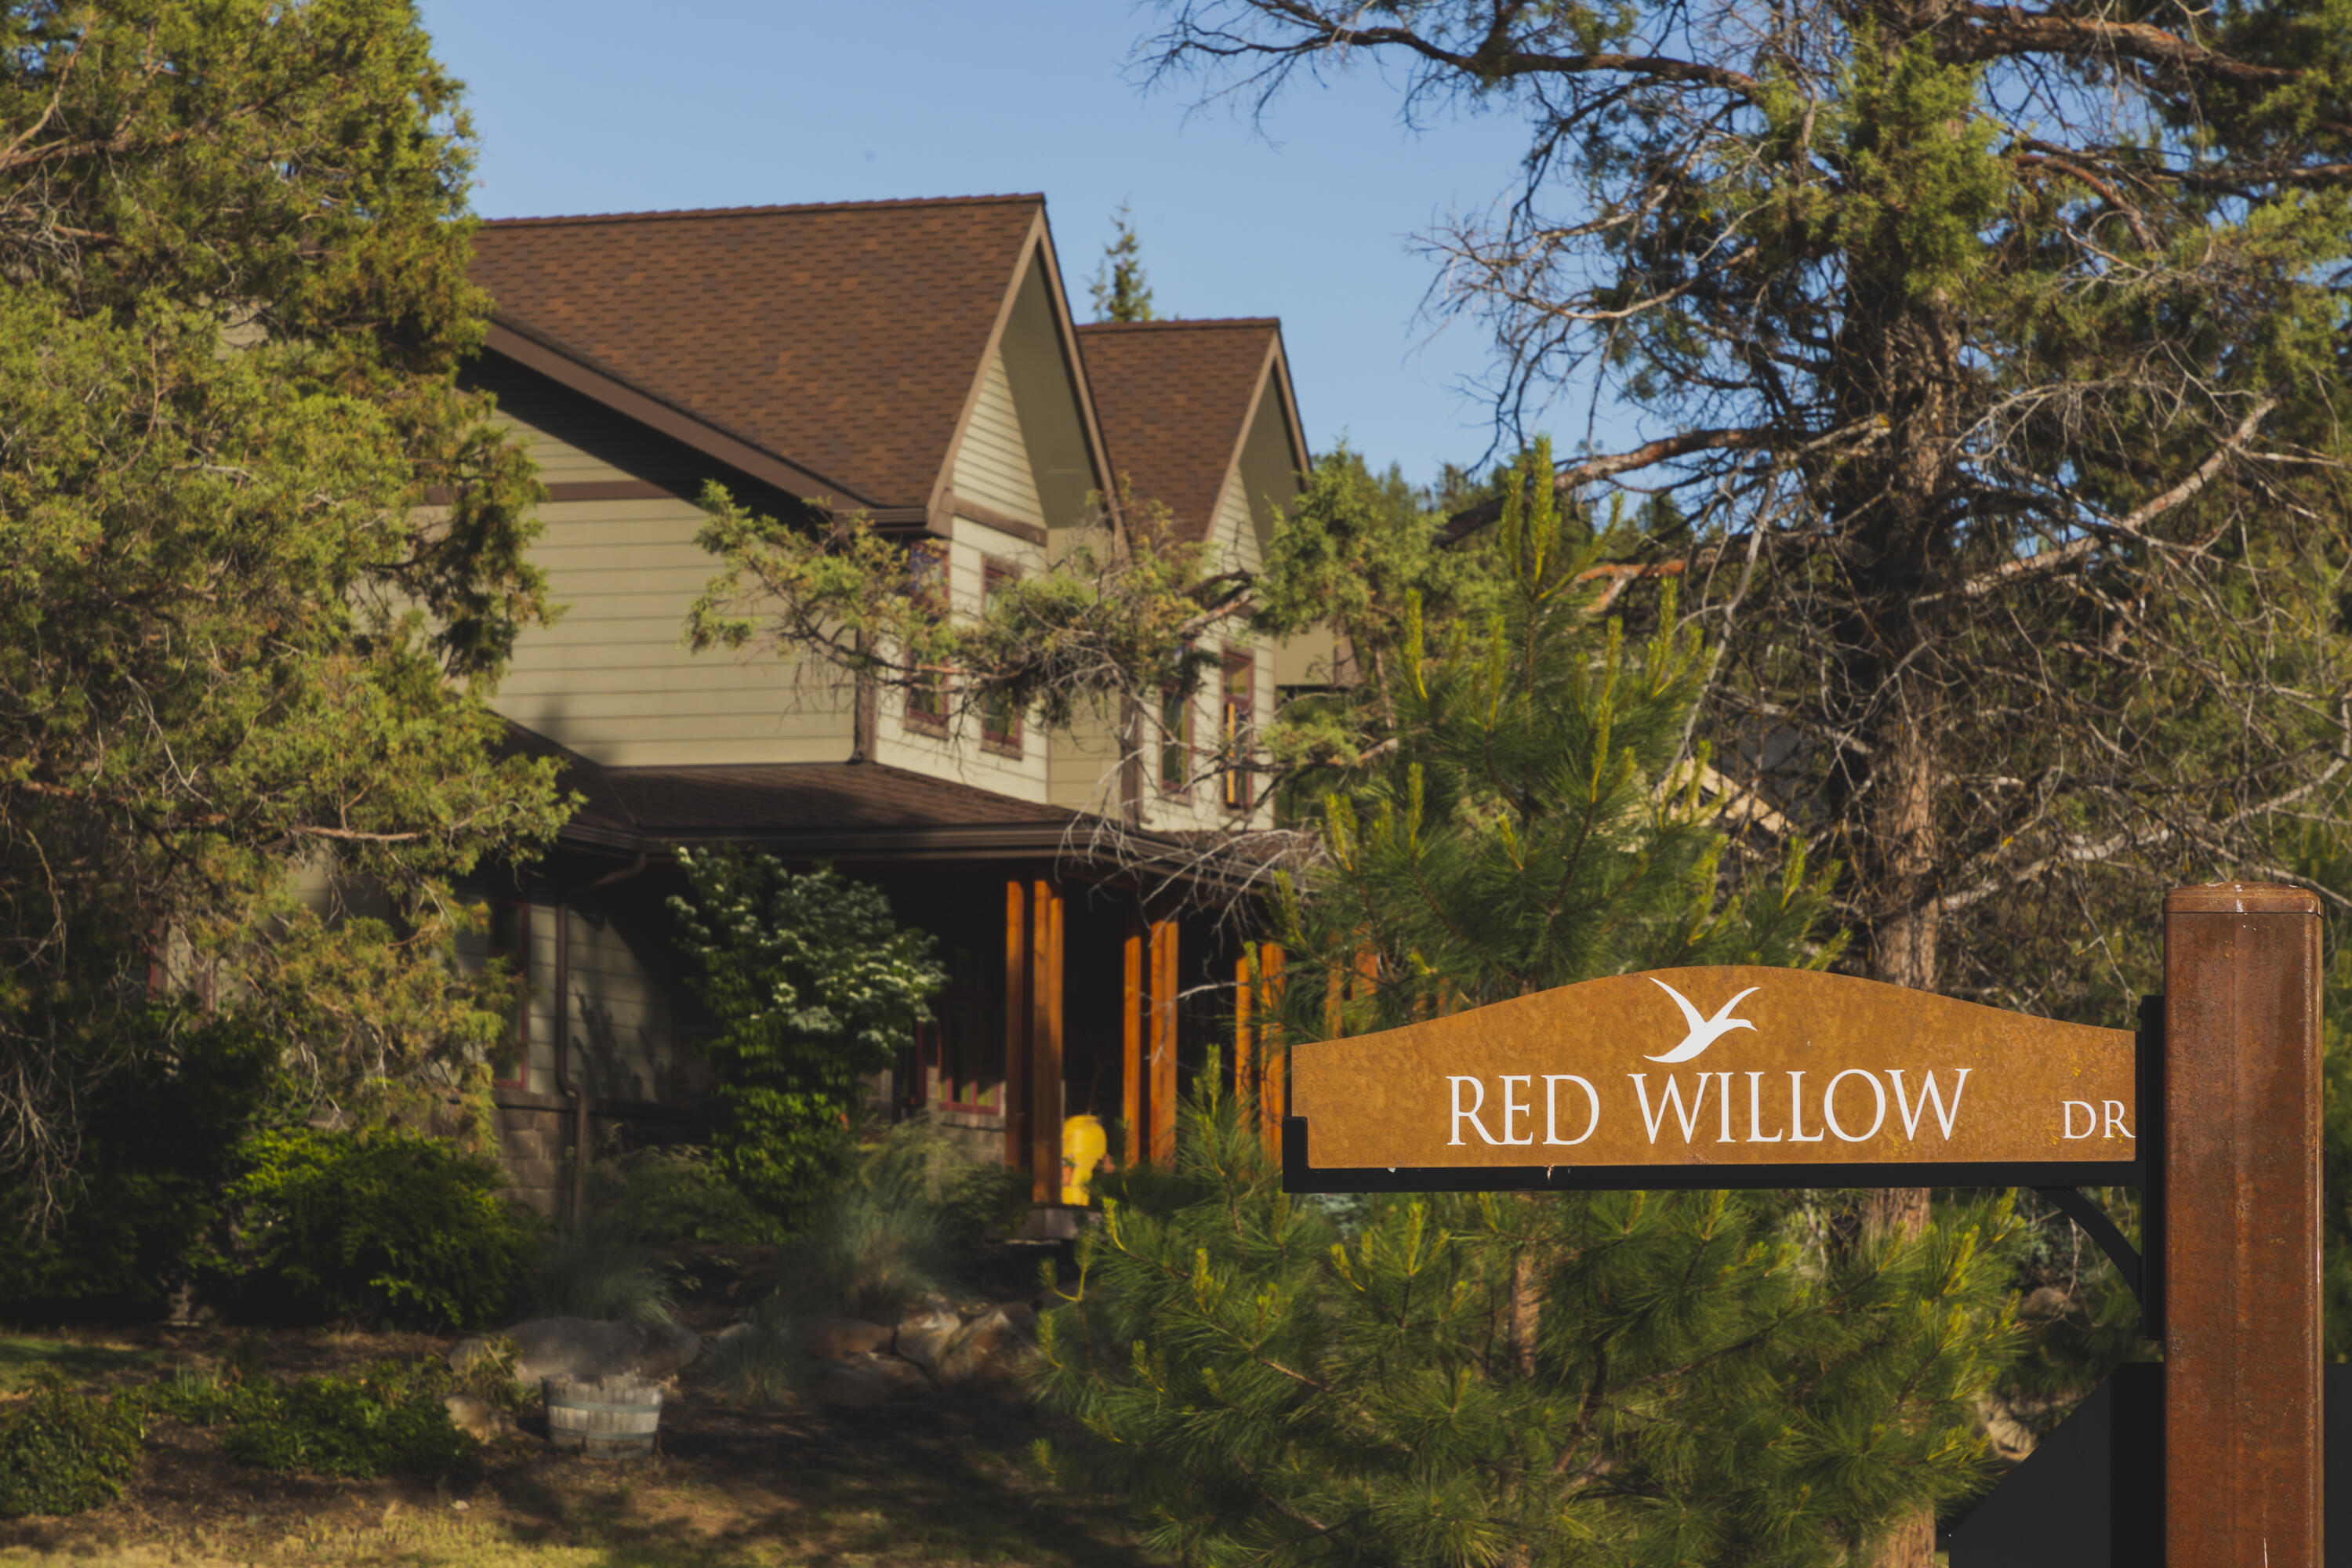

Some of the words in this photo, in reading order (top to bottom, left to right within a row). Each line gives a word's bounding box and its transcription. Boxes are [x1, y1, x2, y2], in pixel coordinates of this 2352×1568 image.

[1446, 1074, 1600, 1145] RED
[1627, 1068, 1973, 1145] WILLOW
[2061, 1100, 2136, 1139] DR
